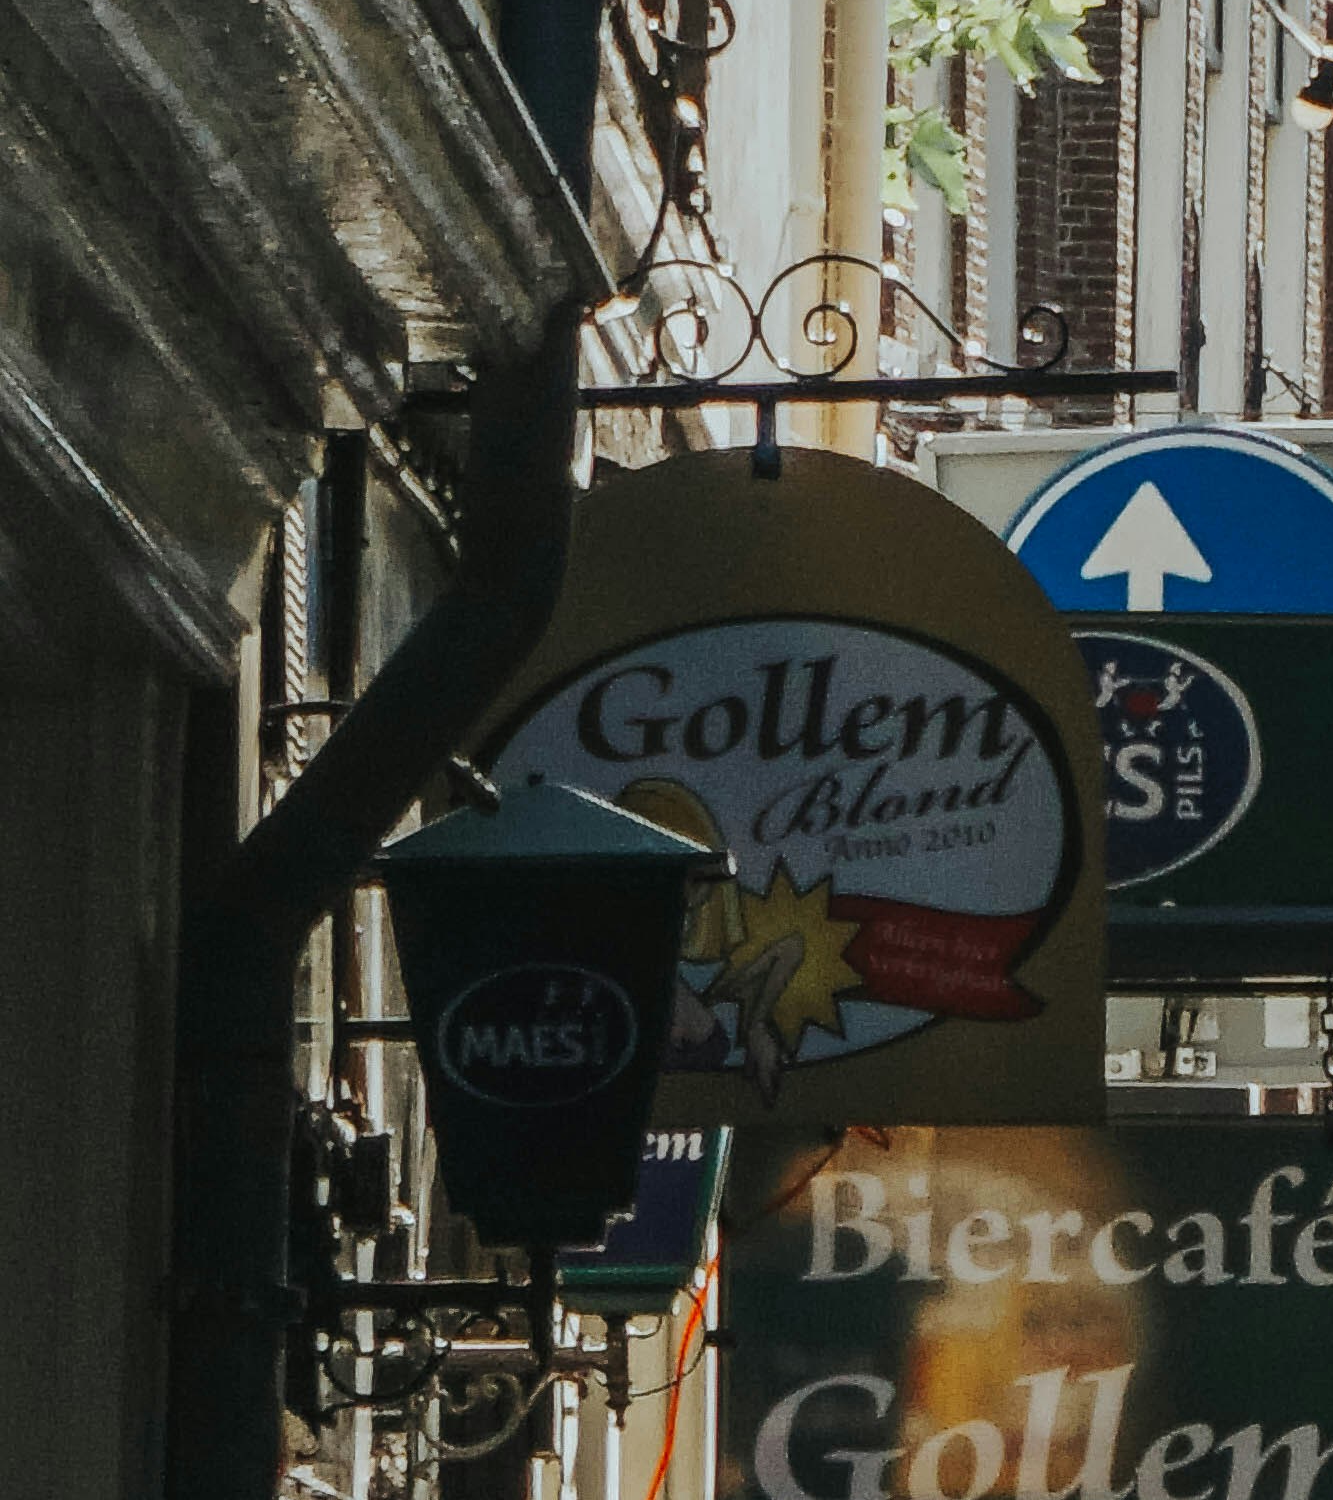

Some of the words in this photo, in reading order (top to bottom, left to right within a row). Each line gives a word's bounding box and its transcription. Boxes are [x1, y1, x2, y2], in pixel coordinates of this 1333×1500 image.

[576, 653, 1018, 763] Gollem
[752, 742, 1034, 847] Blond
[1176, 745, 1204, 821] PILS
[460, 1025, 586, 1067] MAES
